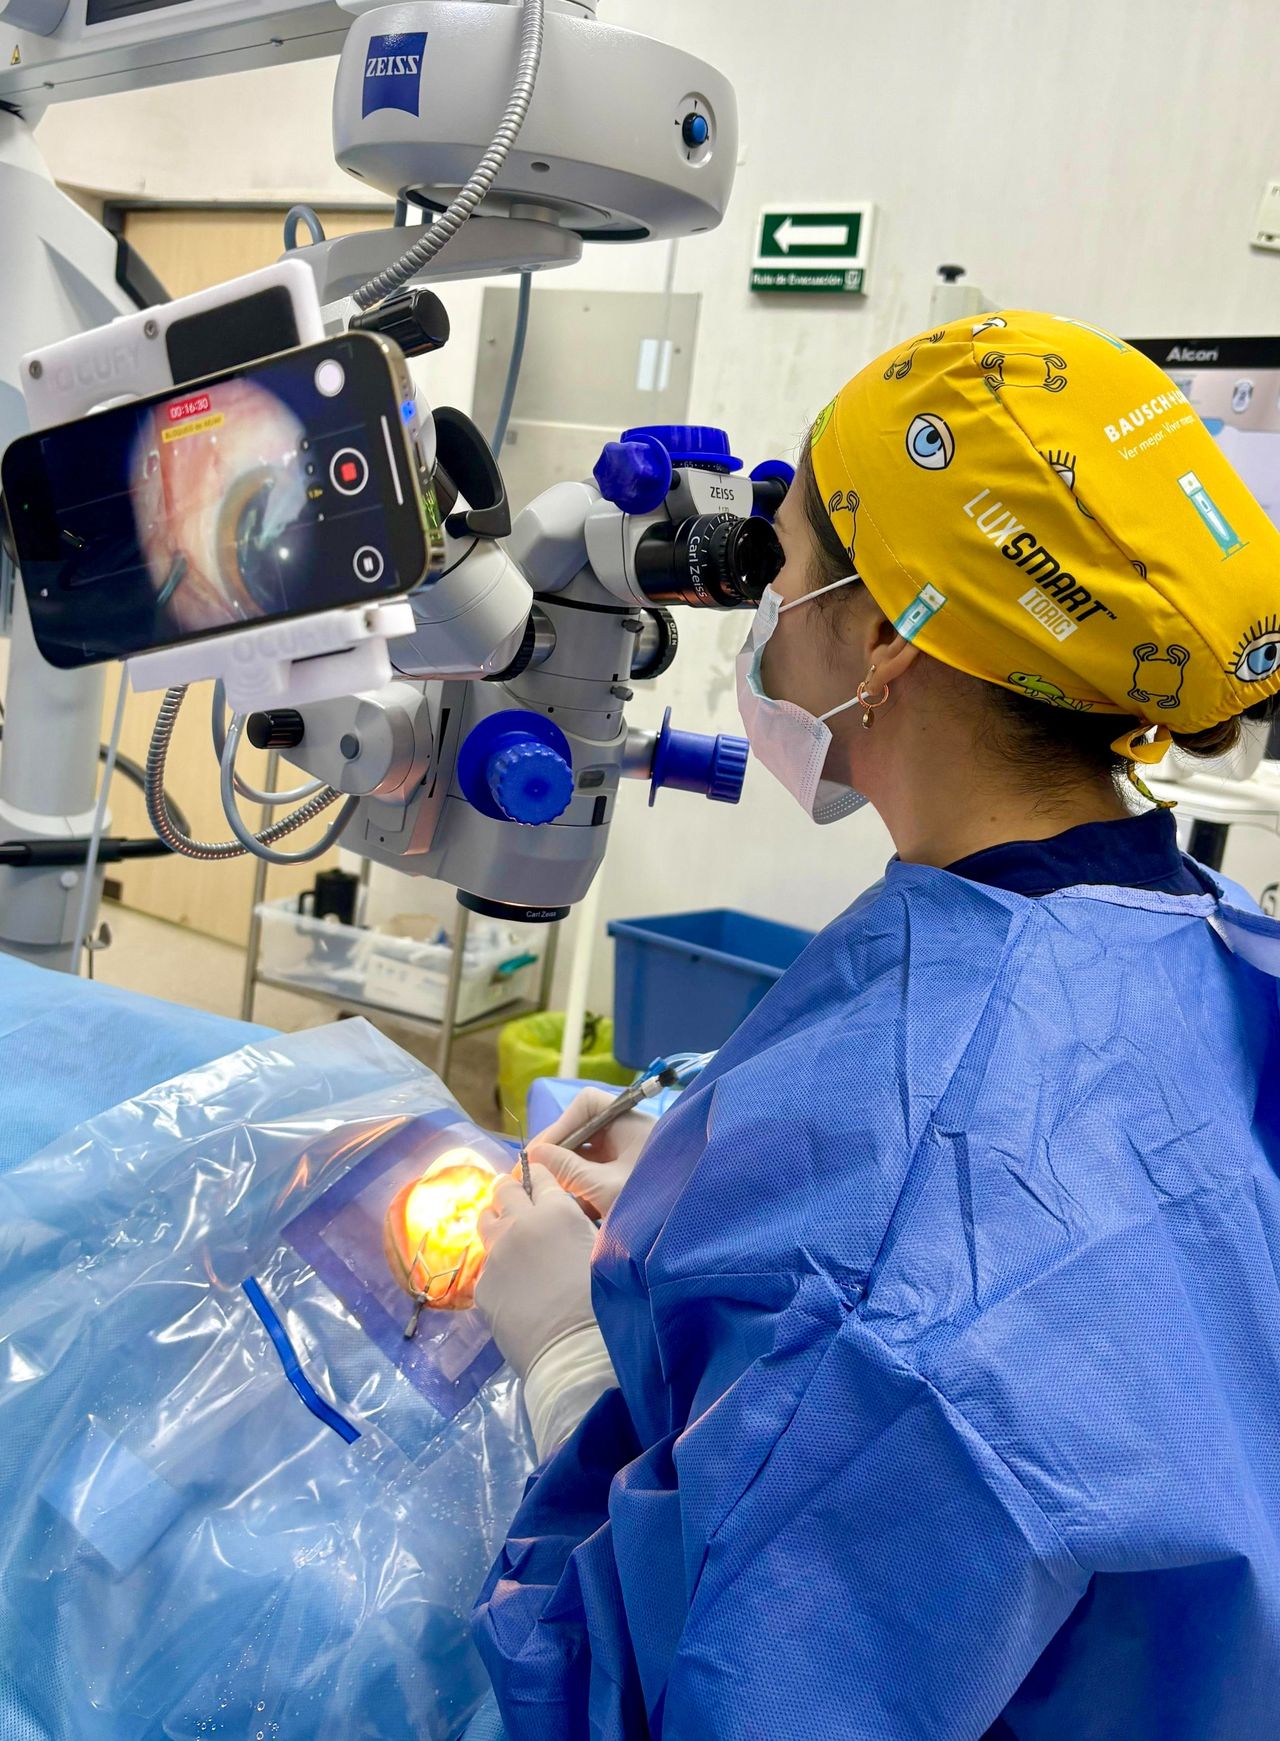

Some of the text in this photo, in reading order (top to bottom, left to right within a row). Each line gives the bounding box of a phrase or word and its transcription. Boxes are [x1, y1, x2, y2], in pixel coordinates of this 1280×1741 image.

[366, 55, 419, 77] ZEISS
[1166, 345, 1219, 361] Alcon
[1118, 446, 1138, 461] Ver
[709, 486, 735, 501] ZEISS
[688, 536, 708, 599] Carl Zeiss
[1023, 590, 1073, 637] TORIC
[669, 622, 677, 646] OPEN
[526, 910, 541, 918] Carl
